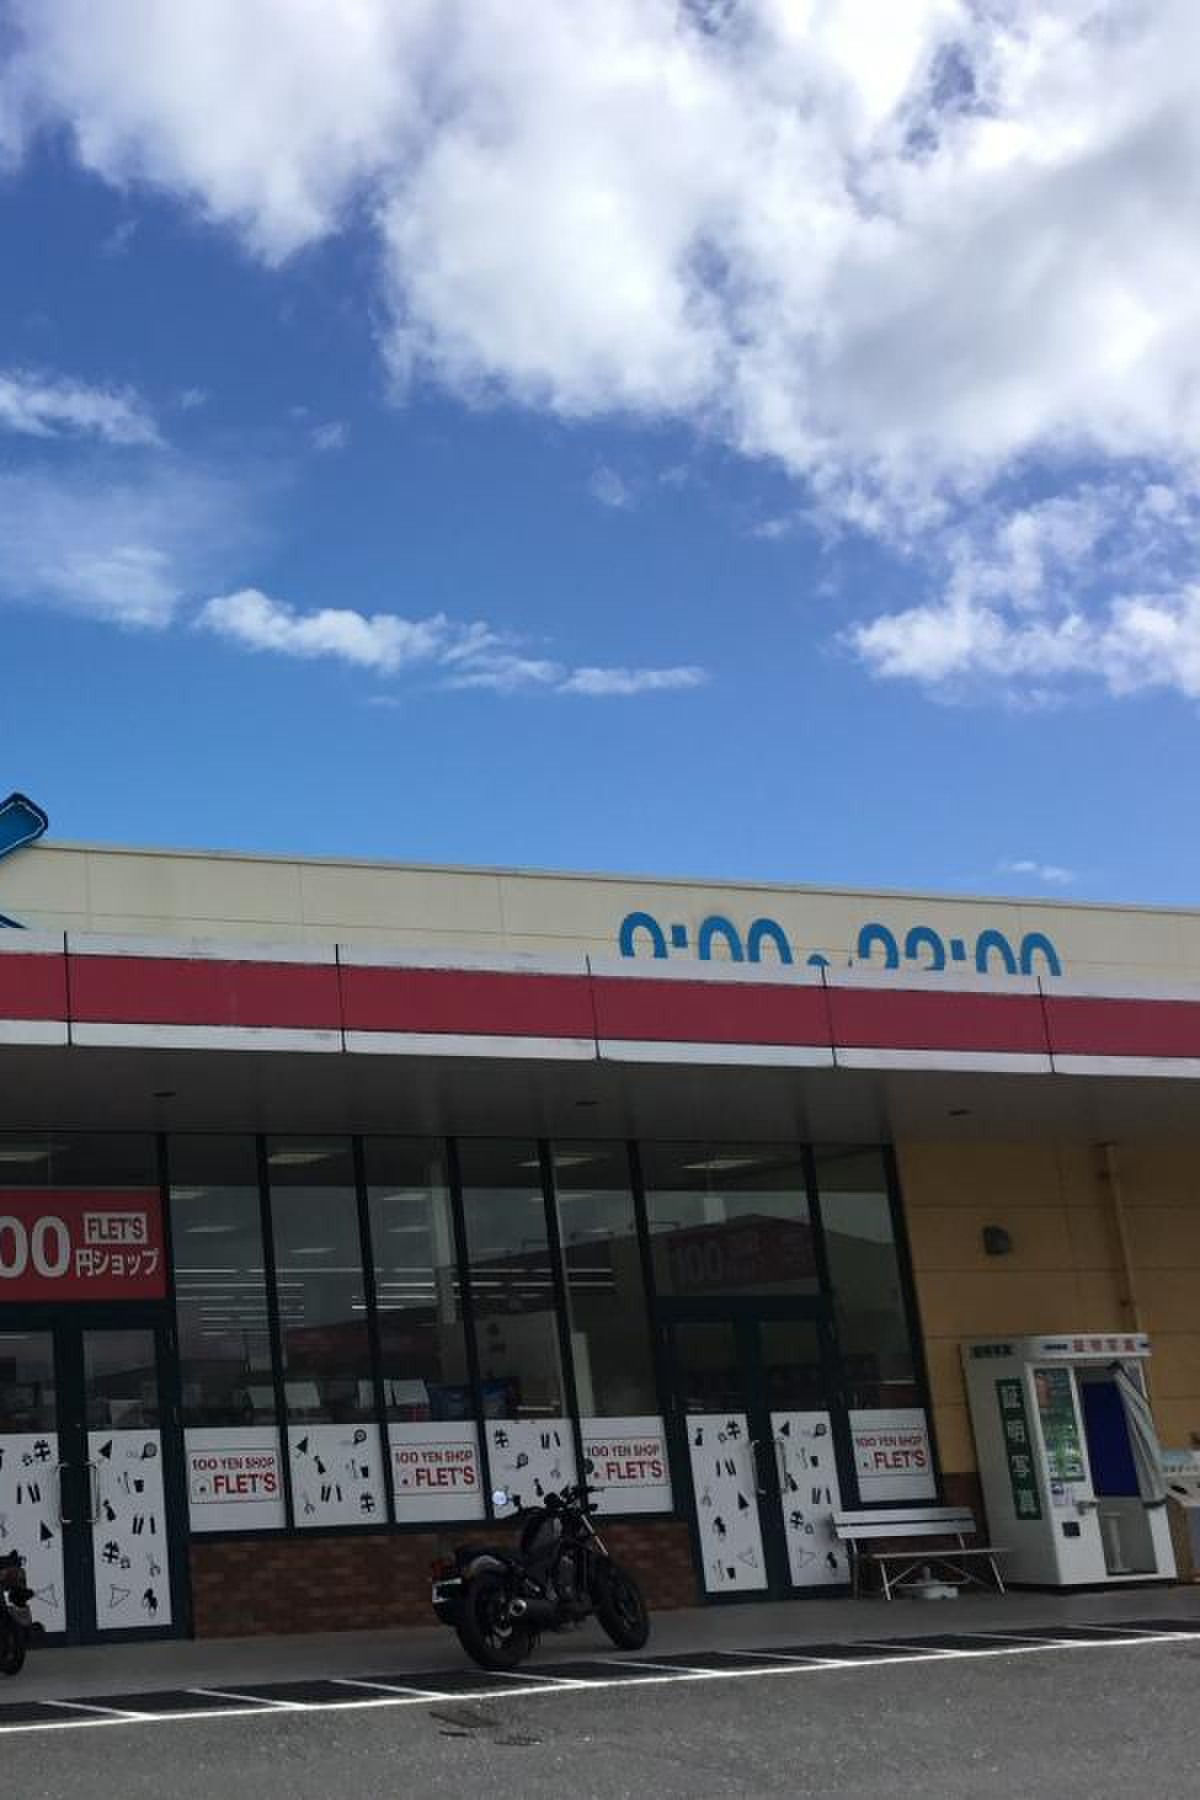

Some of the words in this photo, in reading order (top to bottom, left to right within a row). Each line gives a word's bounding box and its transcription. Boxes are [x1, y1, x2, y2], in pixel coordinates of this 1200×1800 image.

[86, 1217, 144, 1241] FLET'S
[75, 1247, 160, 1279] 円ショップ
[192, 1458, 218, 1471] 100
[221, 1457, 243, 1471] YEN
[245, 1456, 274, 1470] SHOP
[606, 1460, 662, 1480] FLET'S
[213, 1472, 277, 1494] FLET'S
[415, 1465, 475, 1487] FLET'S
